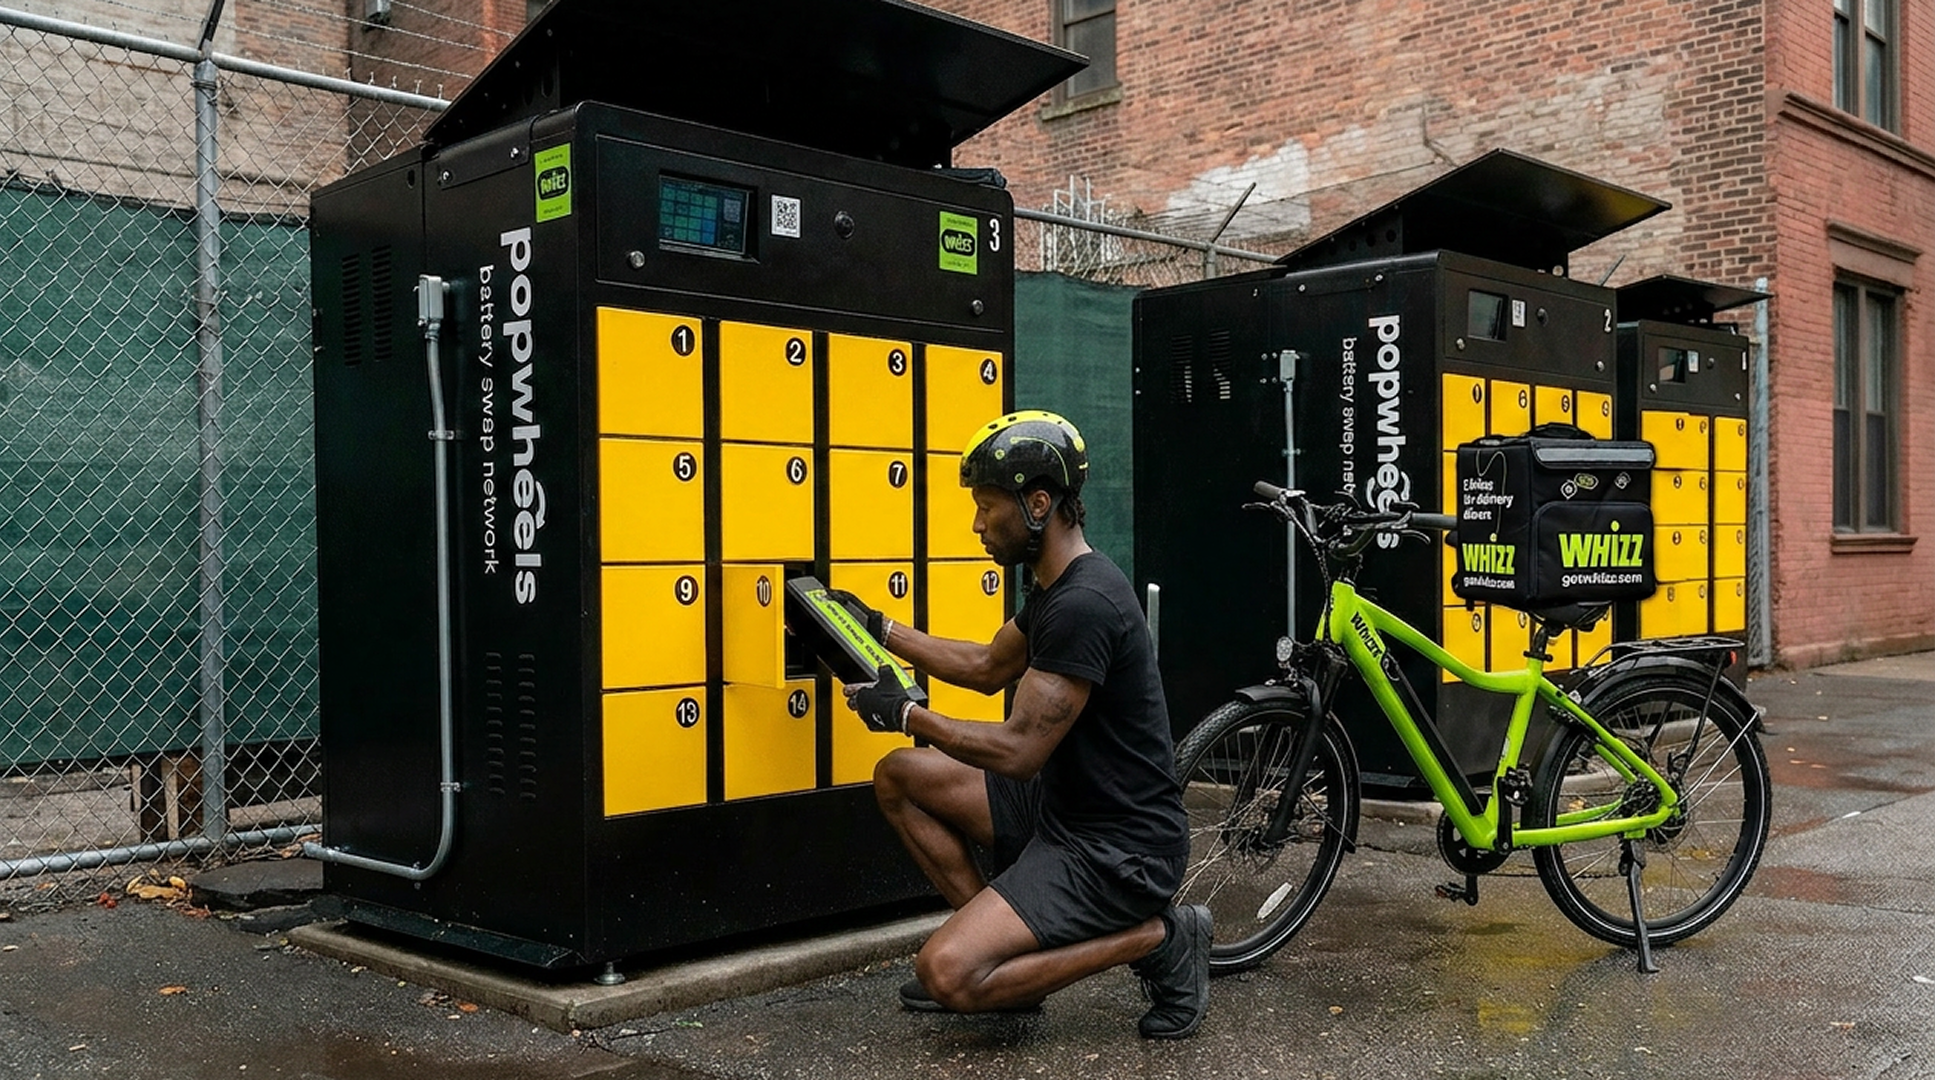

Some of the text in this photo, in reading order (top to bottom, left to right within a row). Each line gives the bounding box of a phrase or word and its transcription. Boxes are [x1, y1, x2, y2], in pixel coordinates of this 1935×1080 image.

[989, 218, 1000, 252] 3
[677, 329, 688, 353] 1
[789, 340, 802, 363] 2
[892, 352, 904, 373] 3
[983, 361, 995, 381] 4
[479, 264, 499, 574] battery swap network
[500, 226, 543, 605] popwheels
[1368, 315, 1406, 549] popwhees
[678, 455, 691, 479] 5
[790, 458, 803, 482] 6
[892, 463, 904, 485] 7
[680, 578, 693, 602] 9
[757, 580, 769, 604] 10
[891, 573, 905, 596] 11
[984, 571, 999, 593] 12
[678, 701, 697, 724] 13
[790, 692, 807, 715] 14
